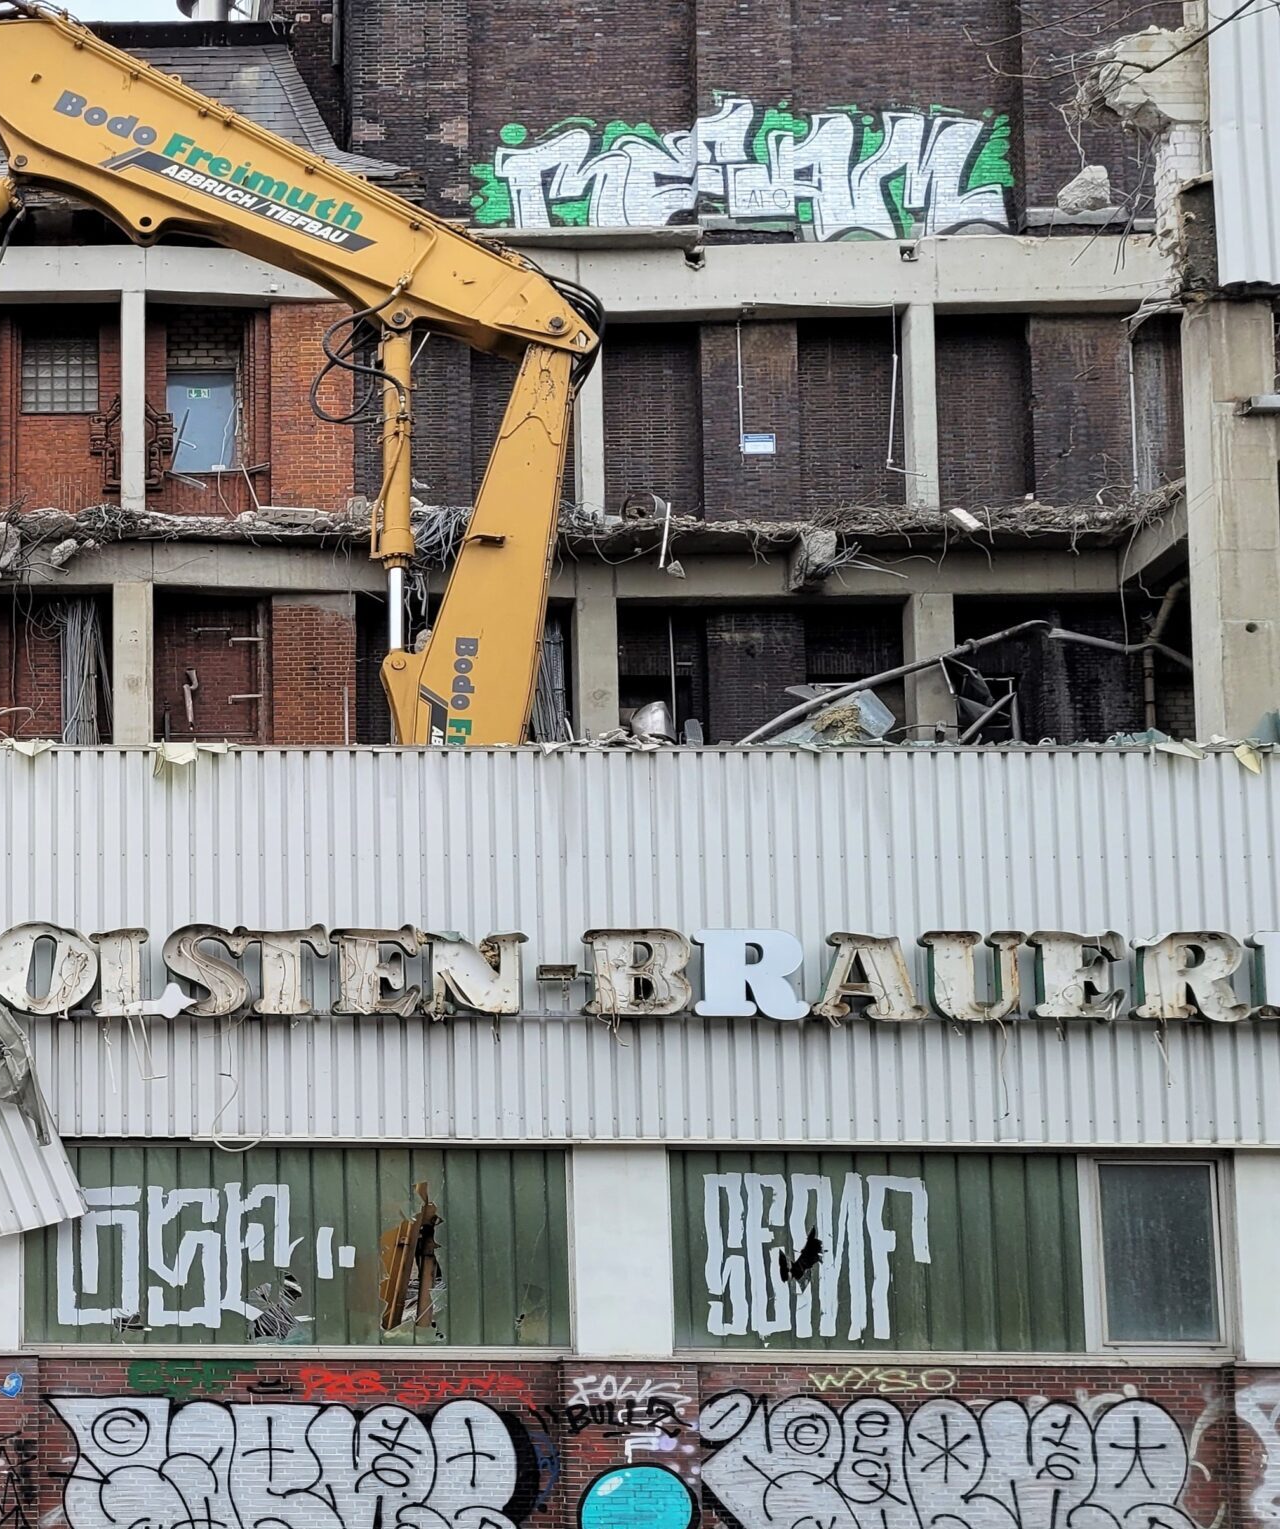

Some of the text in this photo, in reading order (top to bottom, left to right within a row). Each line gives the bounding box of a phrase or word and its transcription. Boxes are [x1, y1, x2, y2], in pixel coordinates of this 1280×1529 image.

[53, 90, 364, 231] Bodo Freimuth
[450, 637, 478, 710] Bodo
[808, 1367, 956, 1391] WYSO
